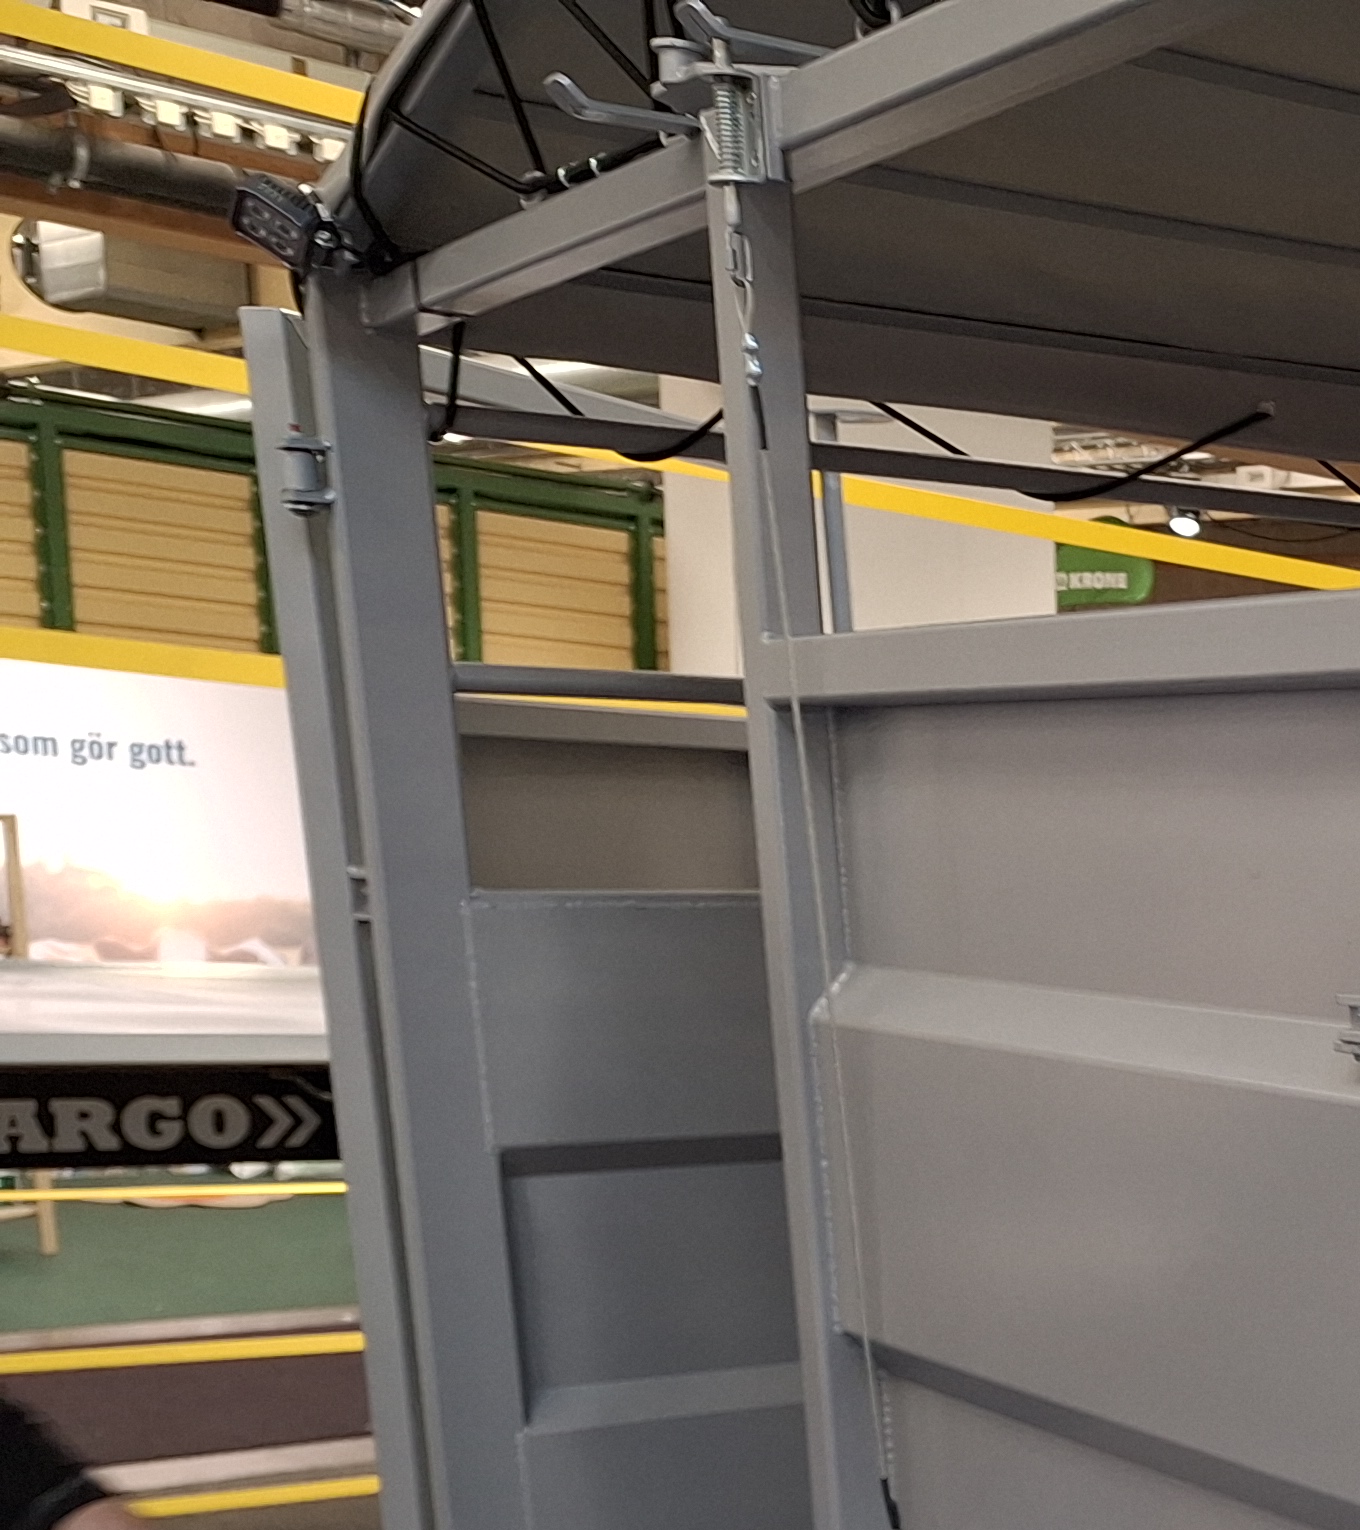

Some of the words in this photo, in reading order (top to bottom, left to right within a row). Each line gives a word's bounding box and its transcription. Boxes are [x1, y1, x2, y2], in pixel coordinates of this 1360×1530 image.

[0, 733, 59, 757] som
[70, 731, 118, 766] gör
[128, 739, 196, 770] gott.
